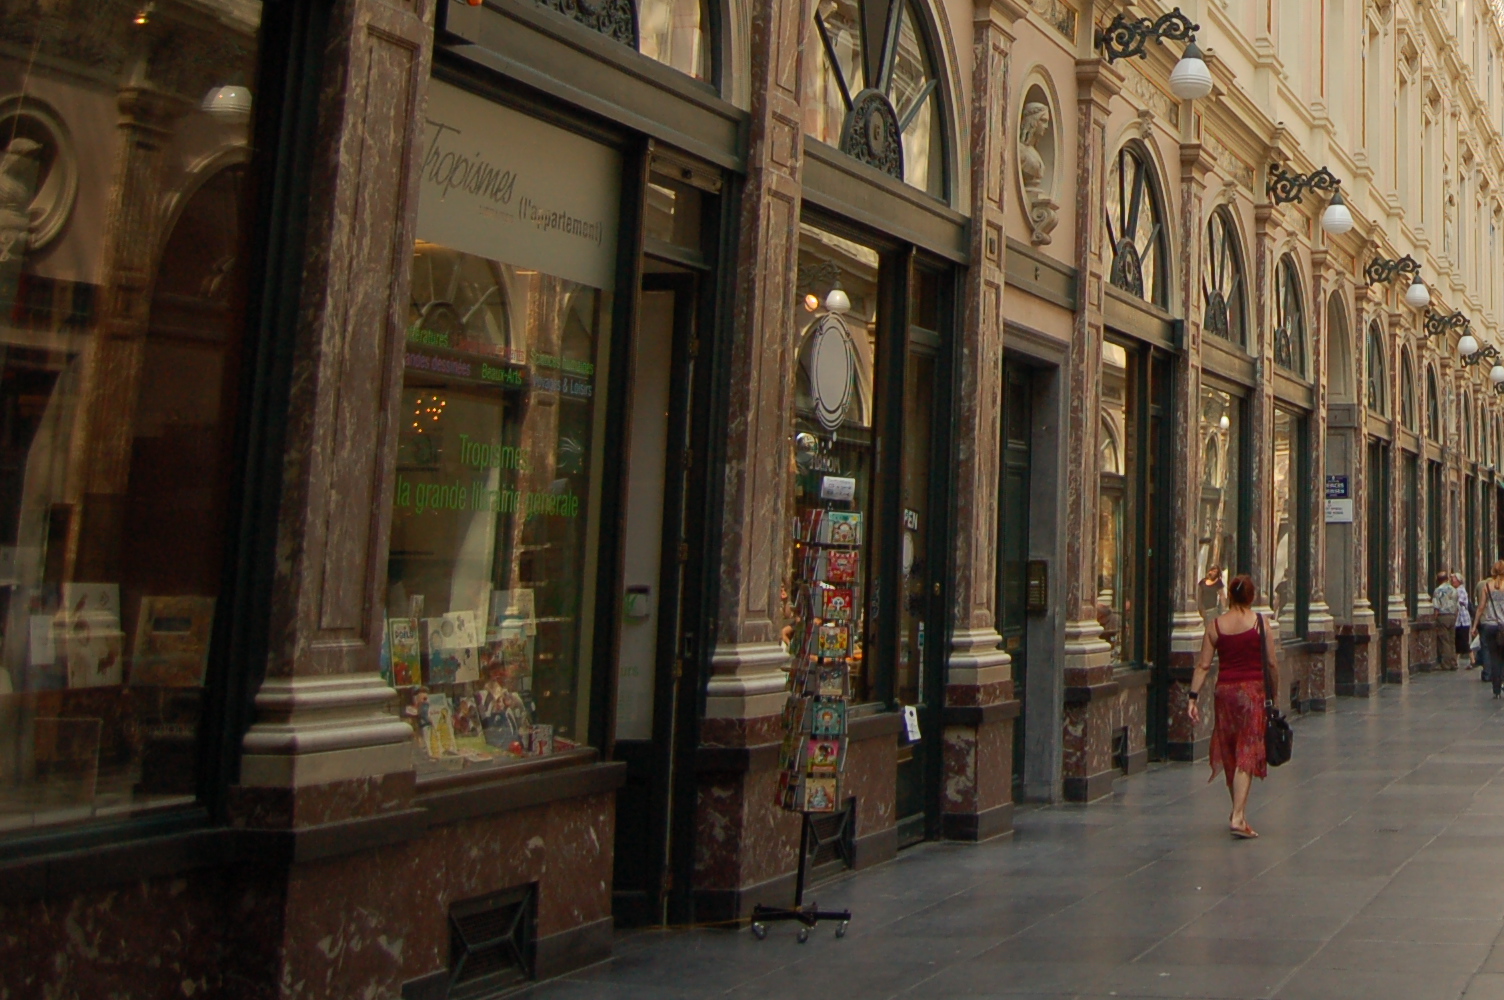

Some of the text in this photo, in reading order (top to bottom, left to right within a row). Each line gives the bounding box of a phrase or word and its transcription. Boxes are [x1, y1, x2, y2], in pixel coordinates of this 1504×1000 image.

[422, 117, 517, 205] Tropismes
[405, 351, 430, 369] andes
[397, 475, 410, 506] la
[415, 480, 467, 515] grande
